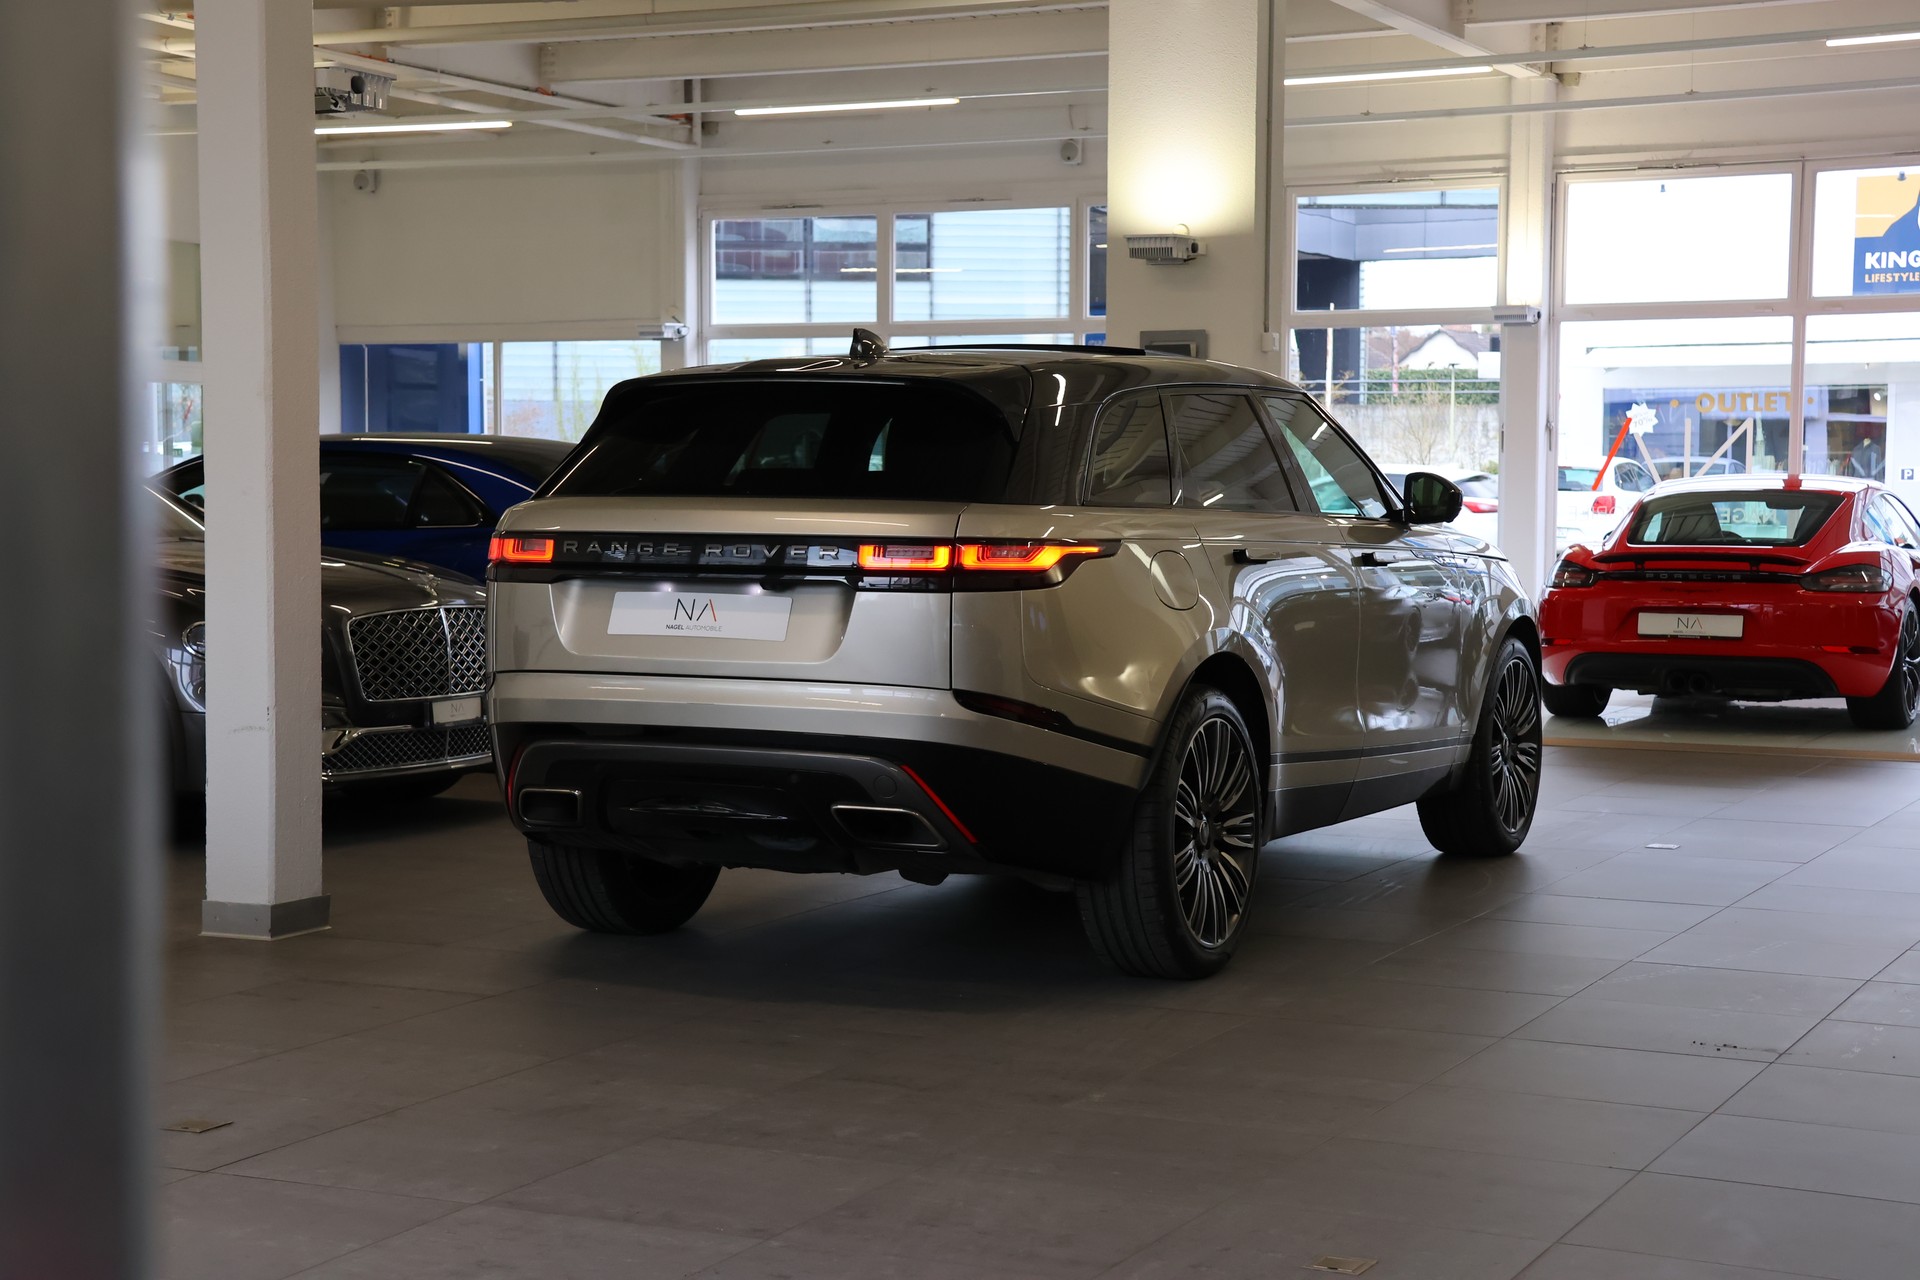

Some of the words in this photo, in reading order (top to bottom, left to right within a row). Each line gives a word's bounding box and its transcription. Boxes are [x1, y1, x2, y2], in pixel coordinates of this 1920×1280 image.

[1864, 271, 1920, 284] LIFESTYLE
[1695, 391, 1791, 413] OUTLET
[563, 540, 680, 556] RANGE
[704, 543, 840, 560] ROVER
[673, 598, 717, 622] NA
[685, 624, 723, 632] AUTOMOBILE
[1676, 616, 1703, 629] NA
